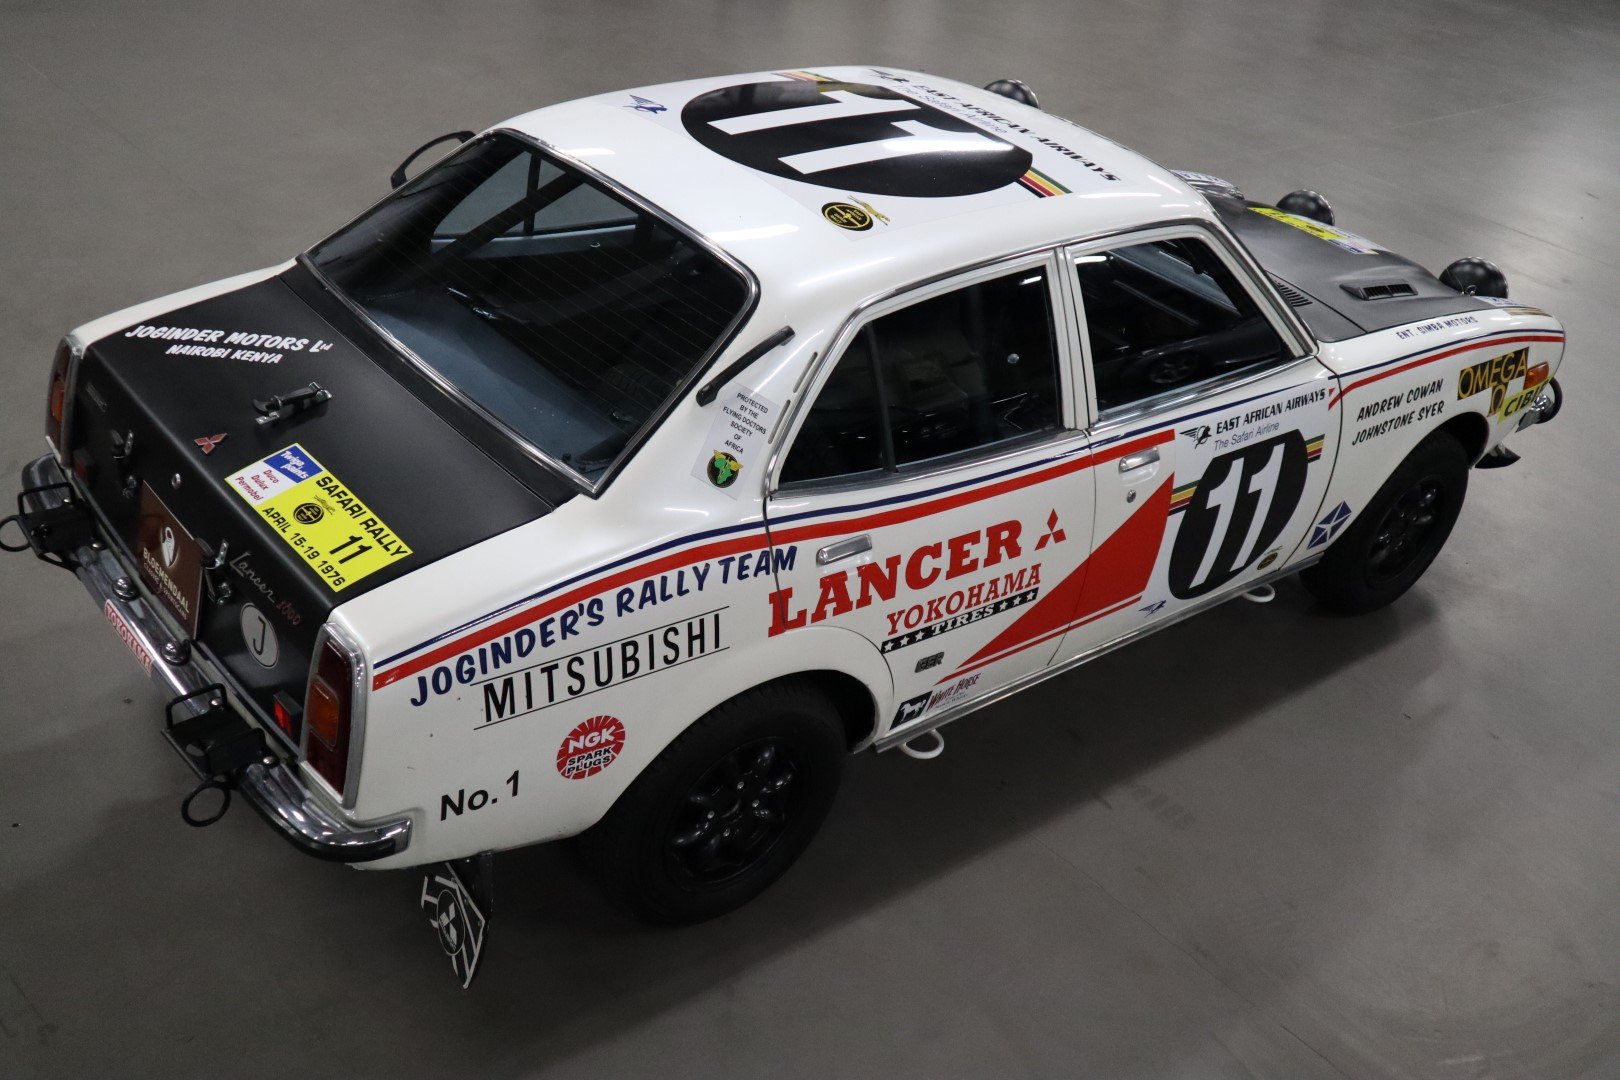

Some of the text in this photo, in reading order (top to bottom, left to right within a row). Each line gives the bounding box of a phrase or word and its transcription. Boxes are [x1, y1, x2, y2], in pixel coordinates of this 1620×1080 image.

[707, 89, 1015, 175] 11
[956, 102, 1036, 134] AFRICAN
[1030, 136, 1121, 181] AIRWAYS
[125, 325, 225, 343] JOGINDER
[223, 331, 309, 352] MOTORS
[1417, 322, 1445, 335] SIMBA
[1444, 316, 1479, 328] MOTORS
[165, 344, 284, 364] NAIROBI KENYA
[1458, 350, 1527, 399] OMEGA
[736, 392, 769, 414] PROTECTED
[739, 404, 759, 419] BY THE
[1216, 388, 1326, 434] EAST AFRICAN AIRWAYS
[1356, 378, 1444, 422] ANDREW COWAN
[723, 406, 767, 435] FLYING DOCTORS
[730, 420, 754, 437] SOCIETY
[1214, 421, 1279, 451] The Safari Airline
[1352, 400, 1445, 446] JOHNSTONE SYER
[724, 440, 744, 454] AFRICA
[733, 433, 742, 441] OF
[235, 476, 264, 501] Permobel
[251, 474, 269, 490] Dulux
[263, 469, 279, 484] Duco
[315, 475, 408, 557] SAFARI RALLY
[1188, 442, 1286, 590] 11
[262, 507, 292, 533] APRIL
[317, 560, 346, 587] 1976
[329, 535, 373, 564] 11
[143, 547, 189, 614] BLOEMENDAAL
[229, 551, 275, 603] Lancer
[768, 519, 1022, 638] LANCER
[886, 563, 1041, 636] YOKOHAMA
[410, 545, 798, 707] JOGINDER'S RALLY TEAM
[932, 603, 995, 635] TIRES
[252, 615, 266, 656] J
[483, 613, 720, 723] MITSUBISHI
[568, 725, 616, 754] NGK
[567, 756, 611, 775] PLUGS
[568, 747, 611, 766] SPARK
[440, 769, 520, 821] No. 1
